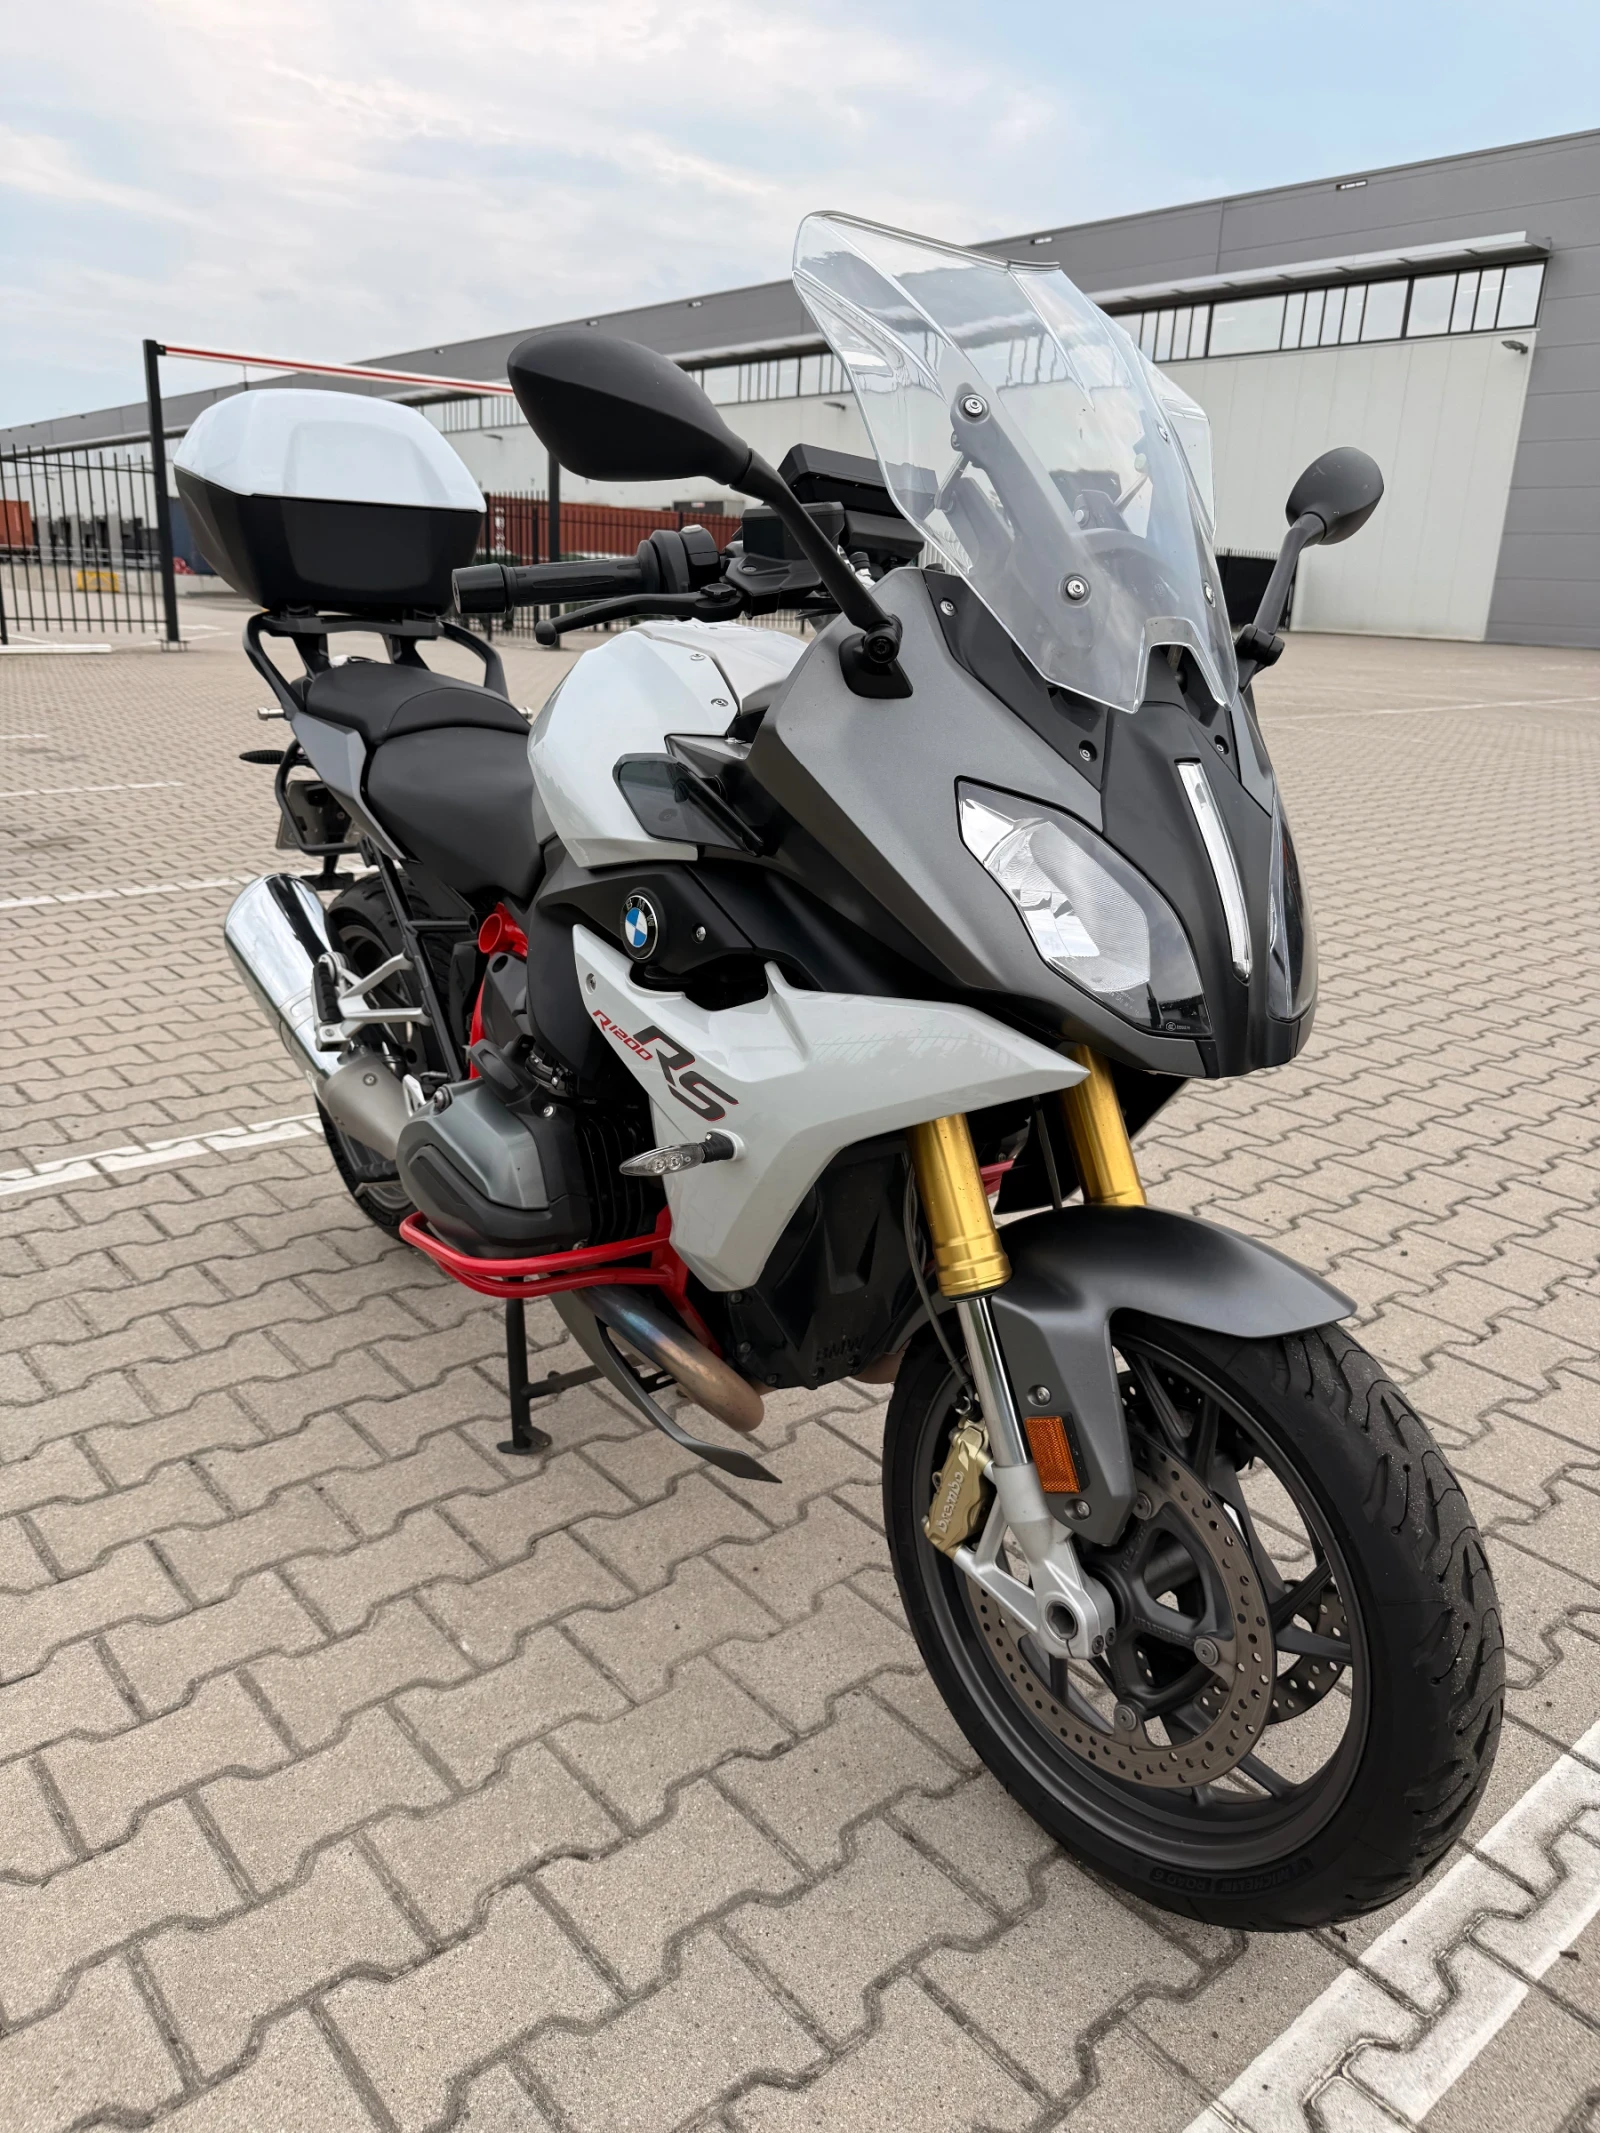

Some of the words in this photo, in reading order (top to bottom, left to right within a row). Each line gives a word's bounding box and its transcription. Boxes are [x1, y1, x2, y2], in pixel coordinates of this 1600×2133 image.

[624, 898, 656, 928] BMW
[633, 1025, 740, 1122] RS
[938, 1471, 965, 1533] brembo
